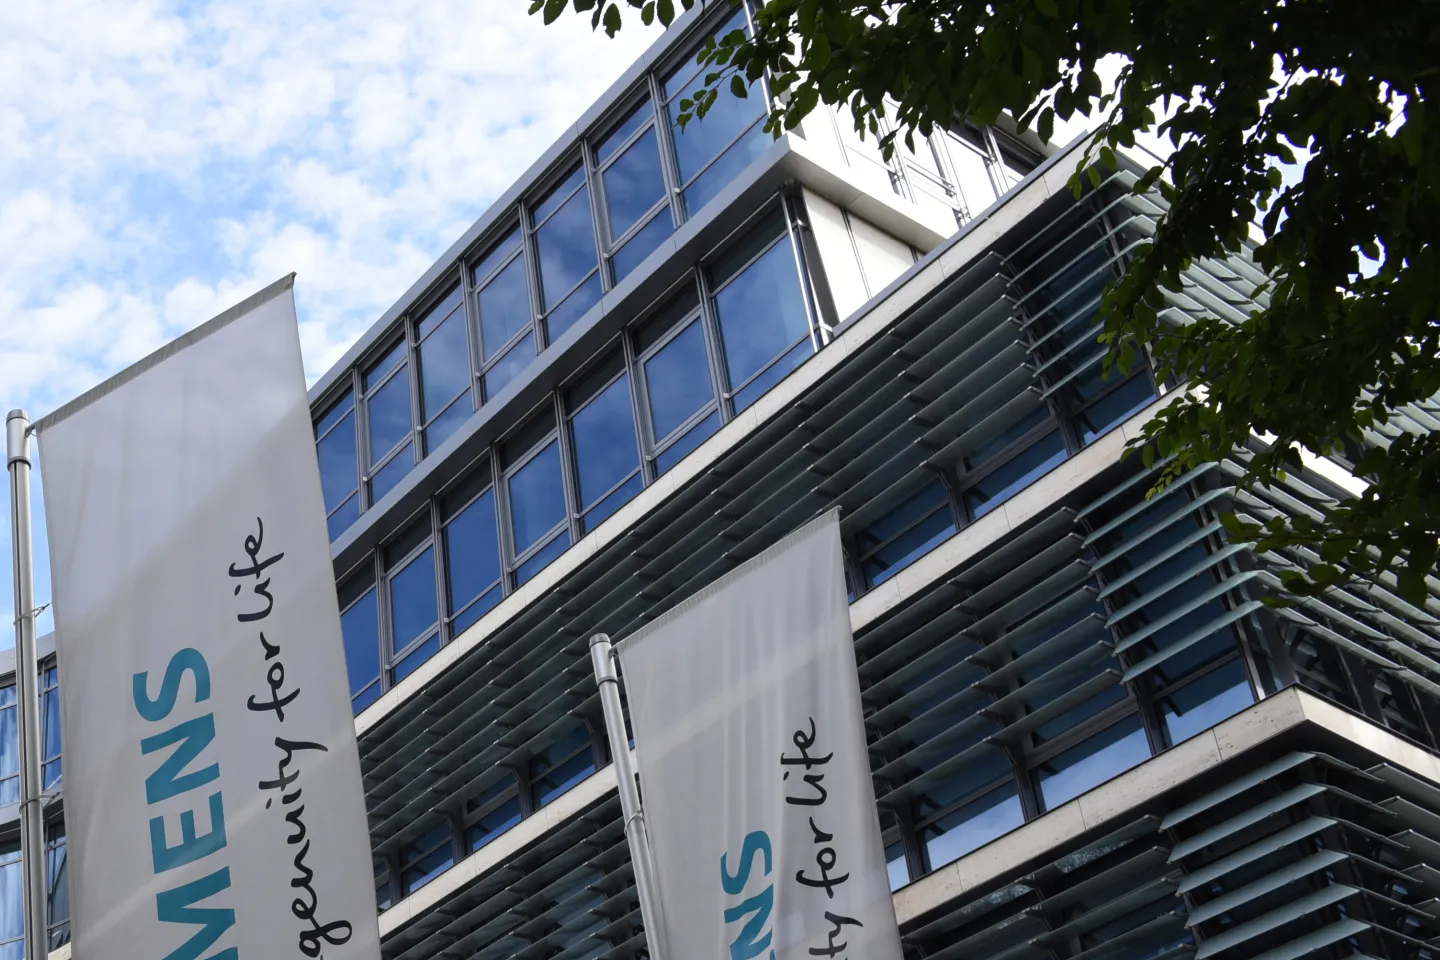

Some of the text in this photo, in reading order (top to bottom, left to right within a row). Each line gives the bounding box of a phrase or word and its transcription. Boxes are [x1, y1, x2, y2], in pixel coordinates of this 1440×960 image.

[228, 516, 285, 623] life
[246, 631, 301, 723] for
[780, 716, 834, 807] life
[795, 816, 850, 899] for
